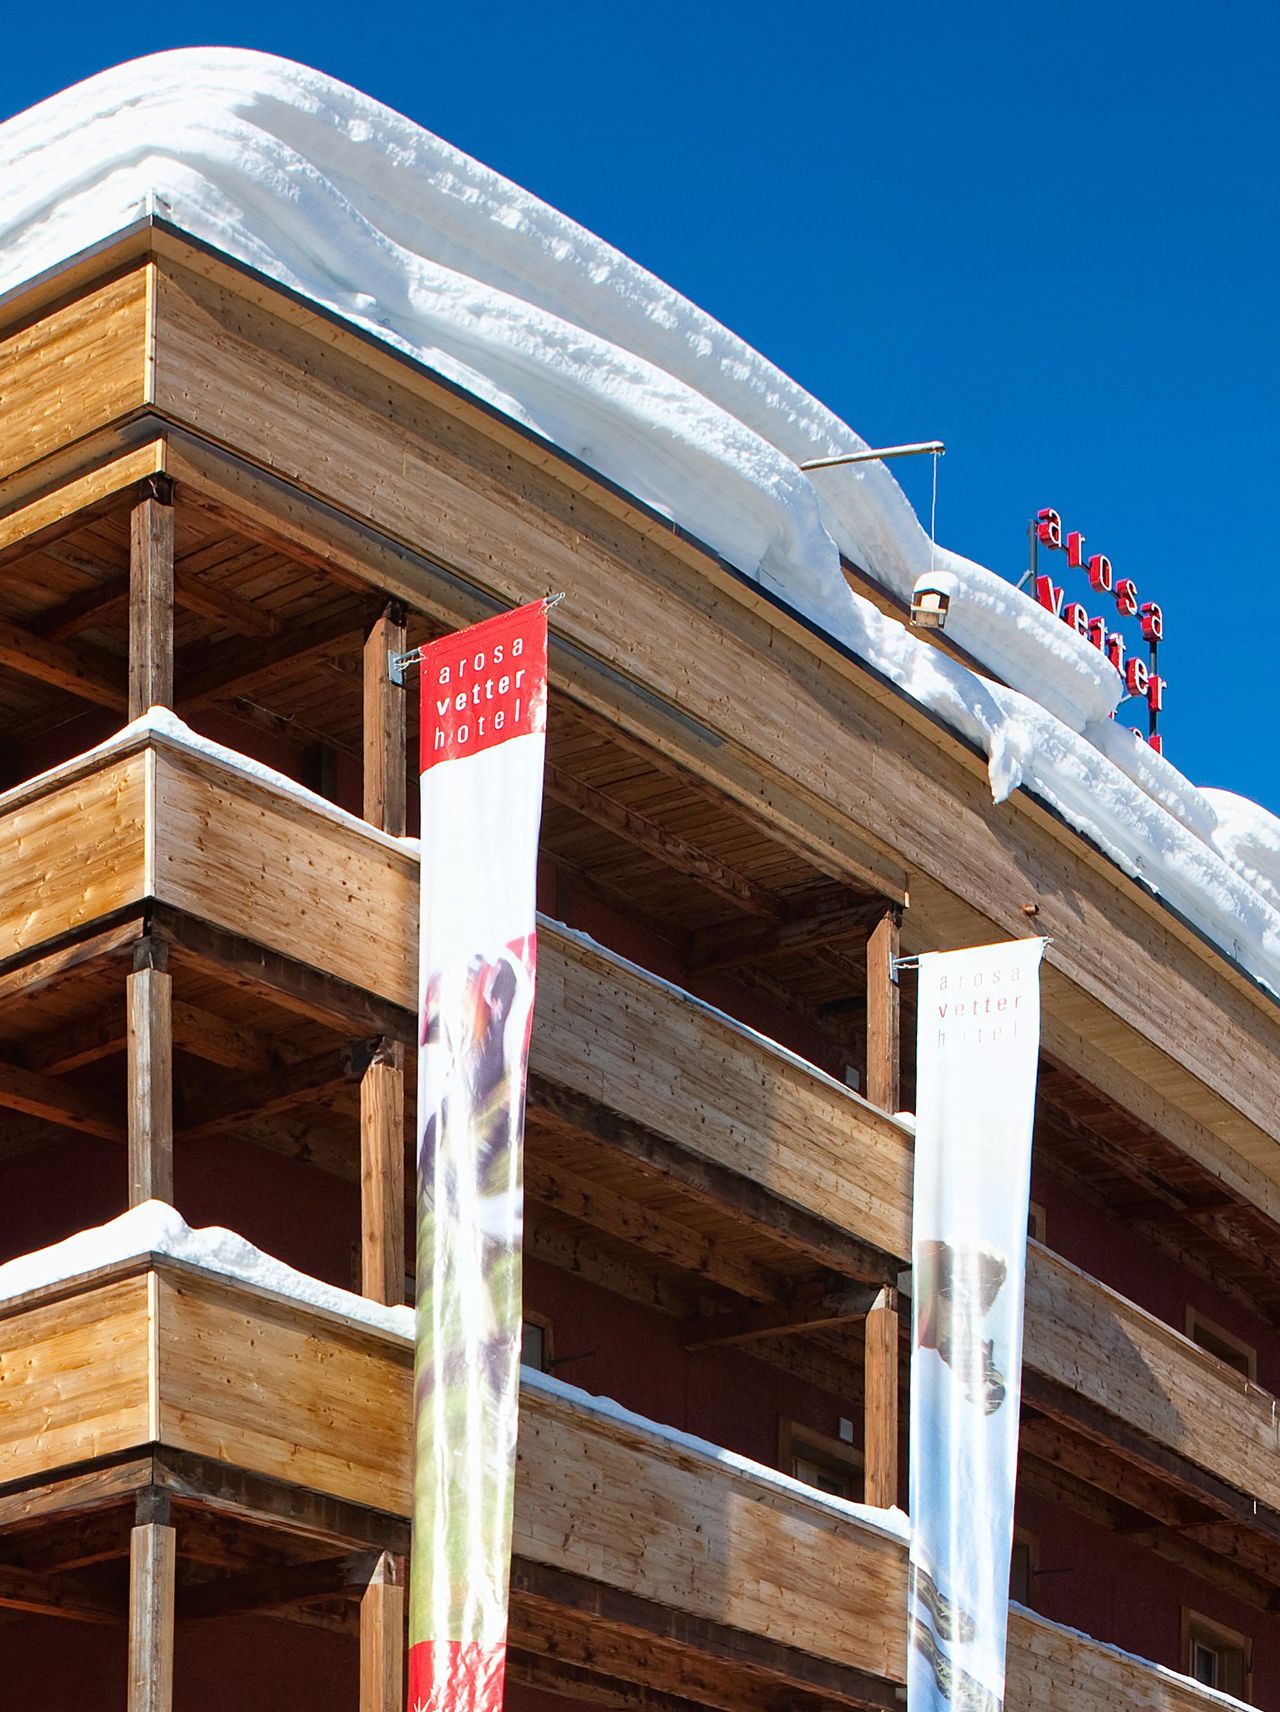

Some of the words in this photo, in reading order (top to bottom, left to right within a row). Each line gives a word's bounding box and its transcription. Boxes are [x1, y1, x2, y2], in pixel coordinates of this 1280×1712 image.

[1037, 508, 1163, 642] arosa
[438, 637, 524, 685] arosa
[1036, 575, 1167, 712] vetter
[436, 668, 526, 717] vetter
[434, 698, 521, 751] hotel
[938, 966, 1020, 991] arosa
[938, 995, 1022, 1018] vetter
